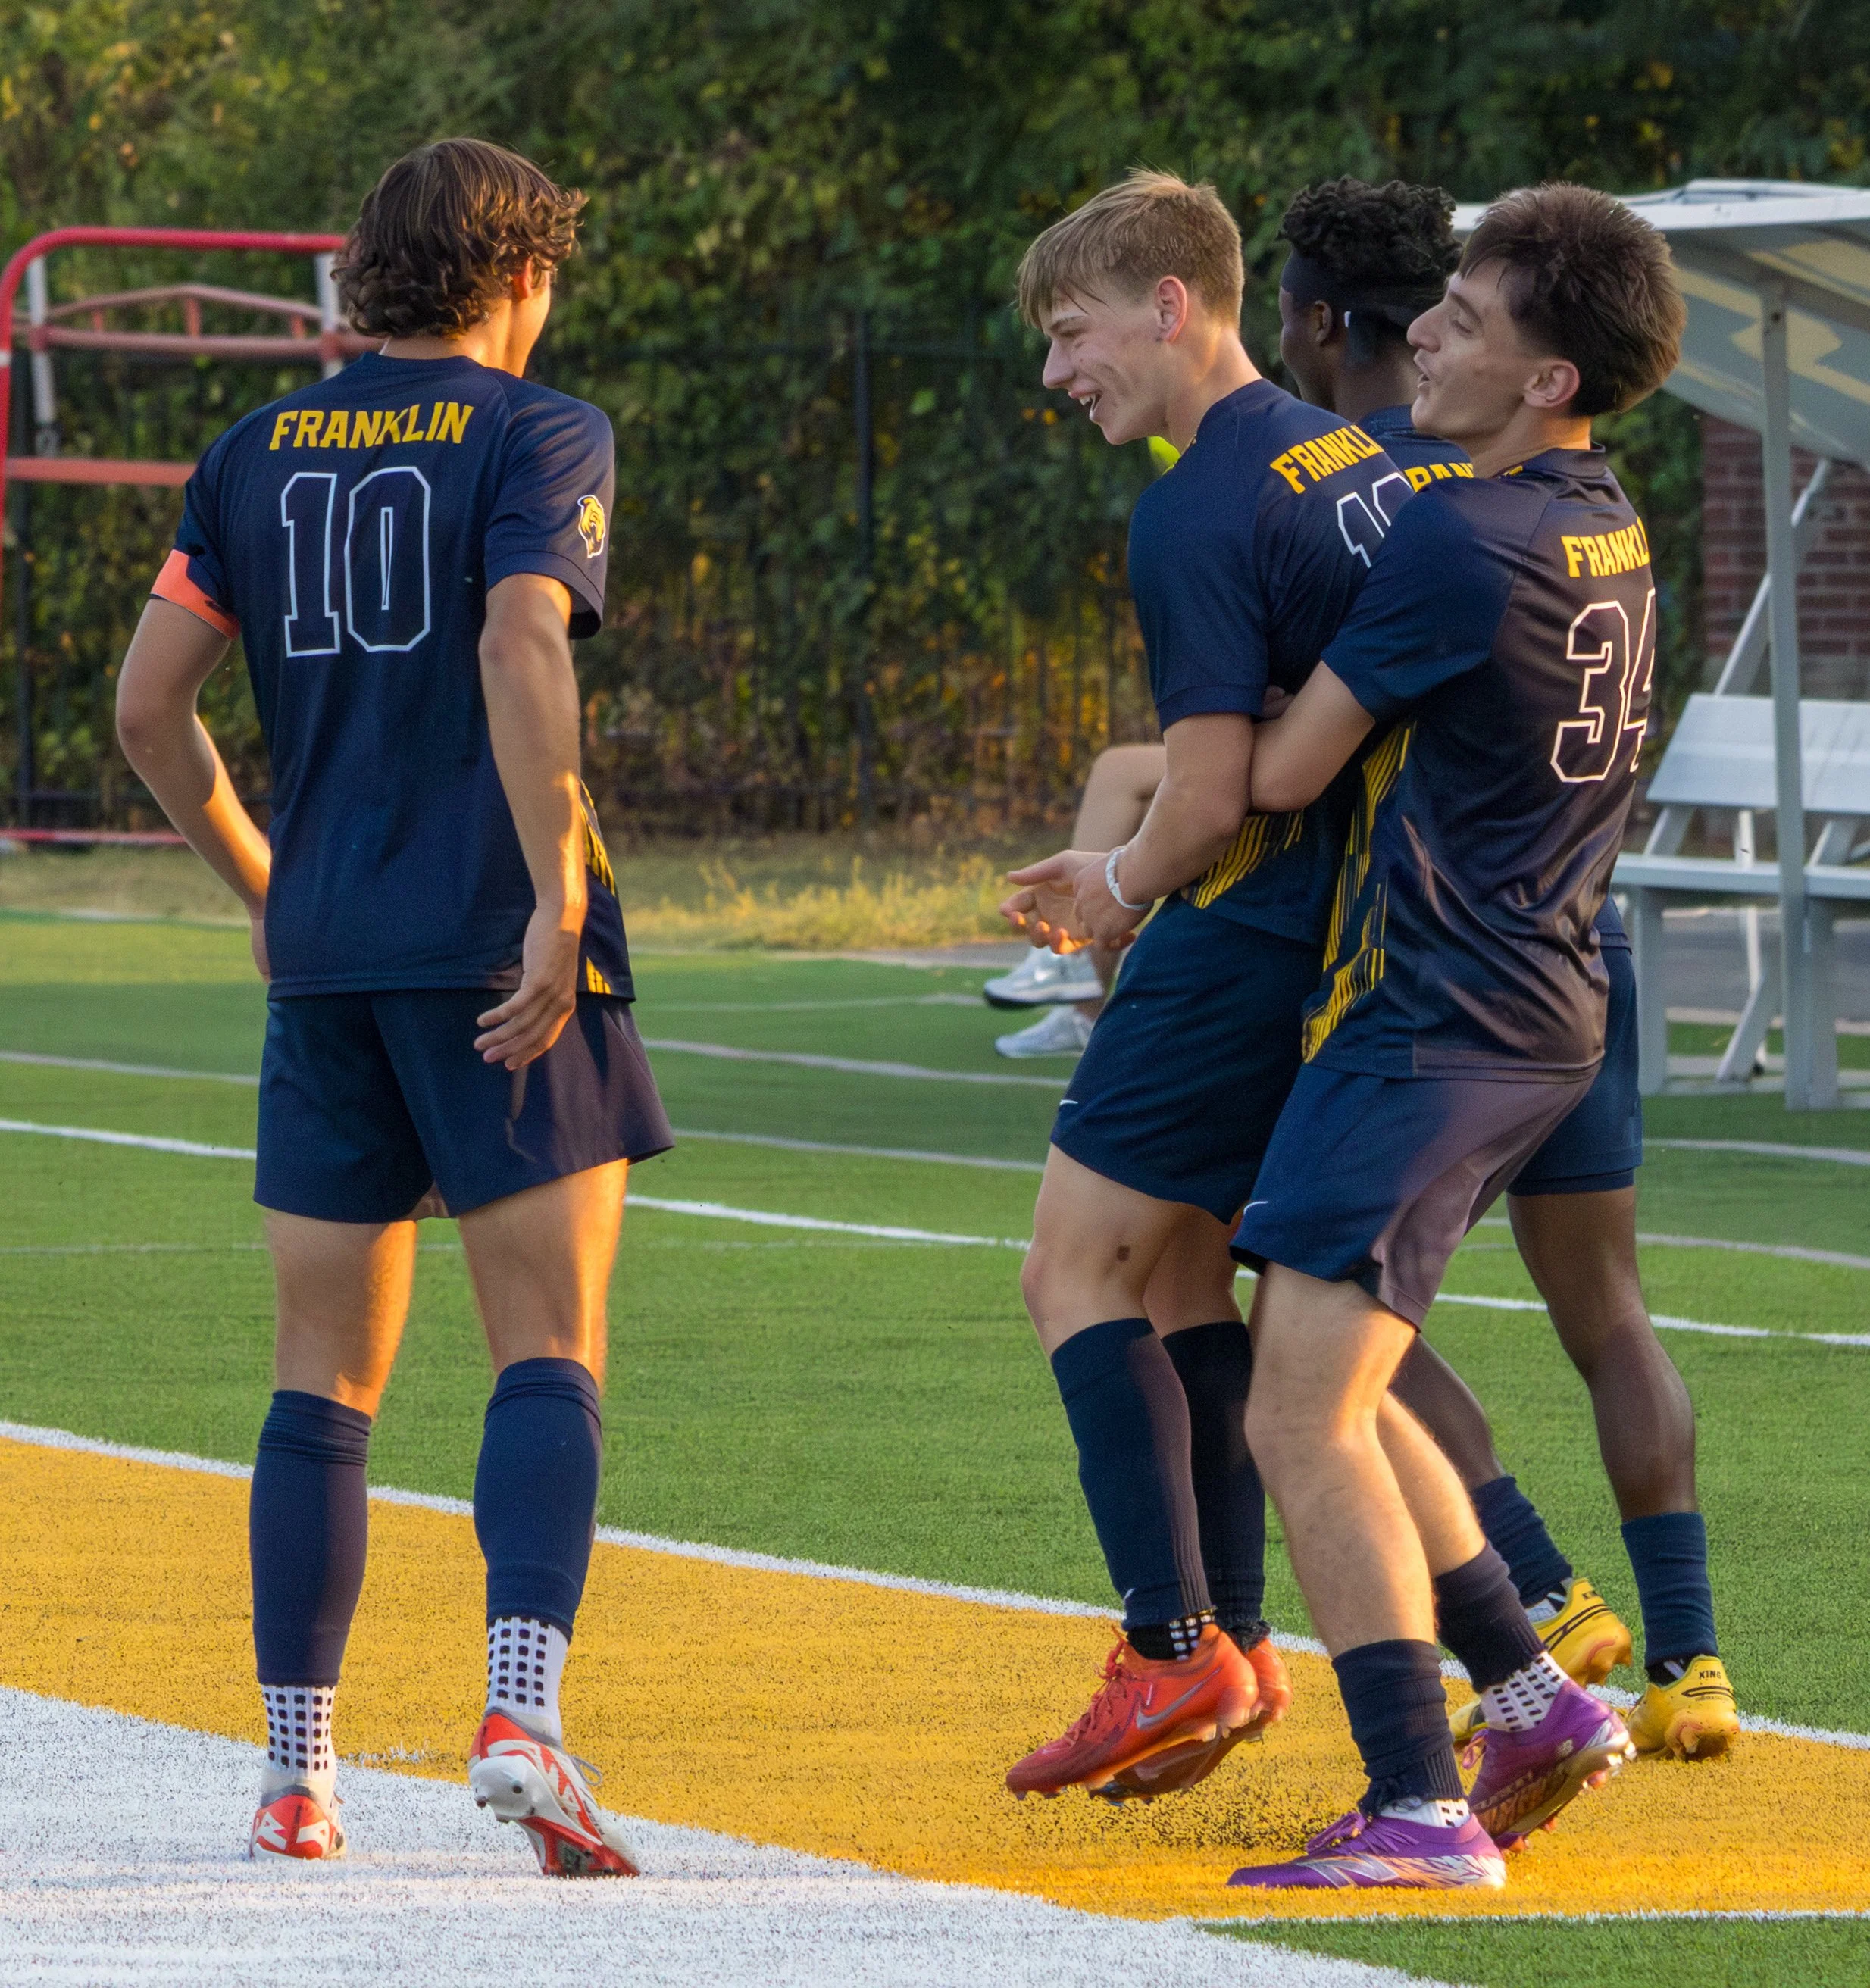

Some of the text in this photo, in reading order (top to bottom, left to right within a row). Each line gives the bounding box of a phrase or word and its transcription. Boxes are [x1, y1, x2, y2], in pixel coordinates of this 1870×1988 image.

[269, 402, 474, 450] FRANKLIN
[280, 466, 431, 657] 10
[1699, 1670, 1722, 1680] KING
